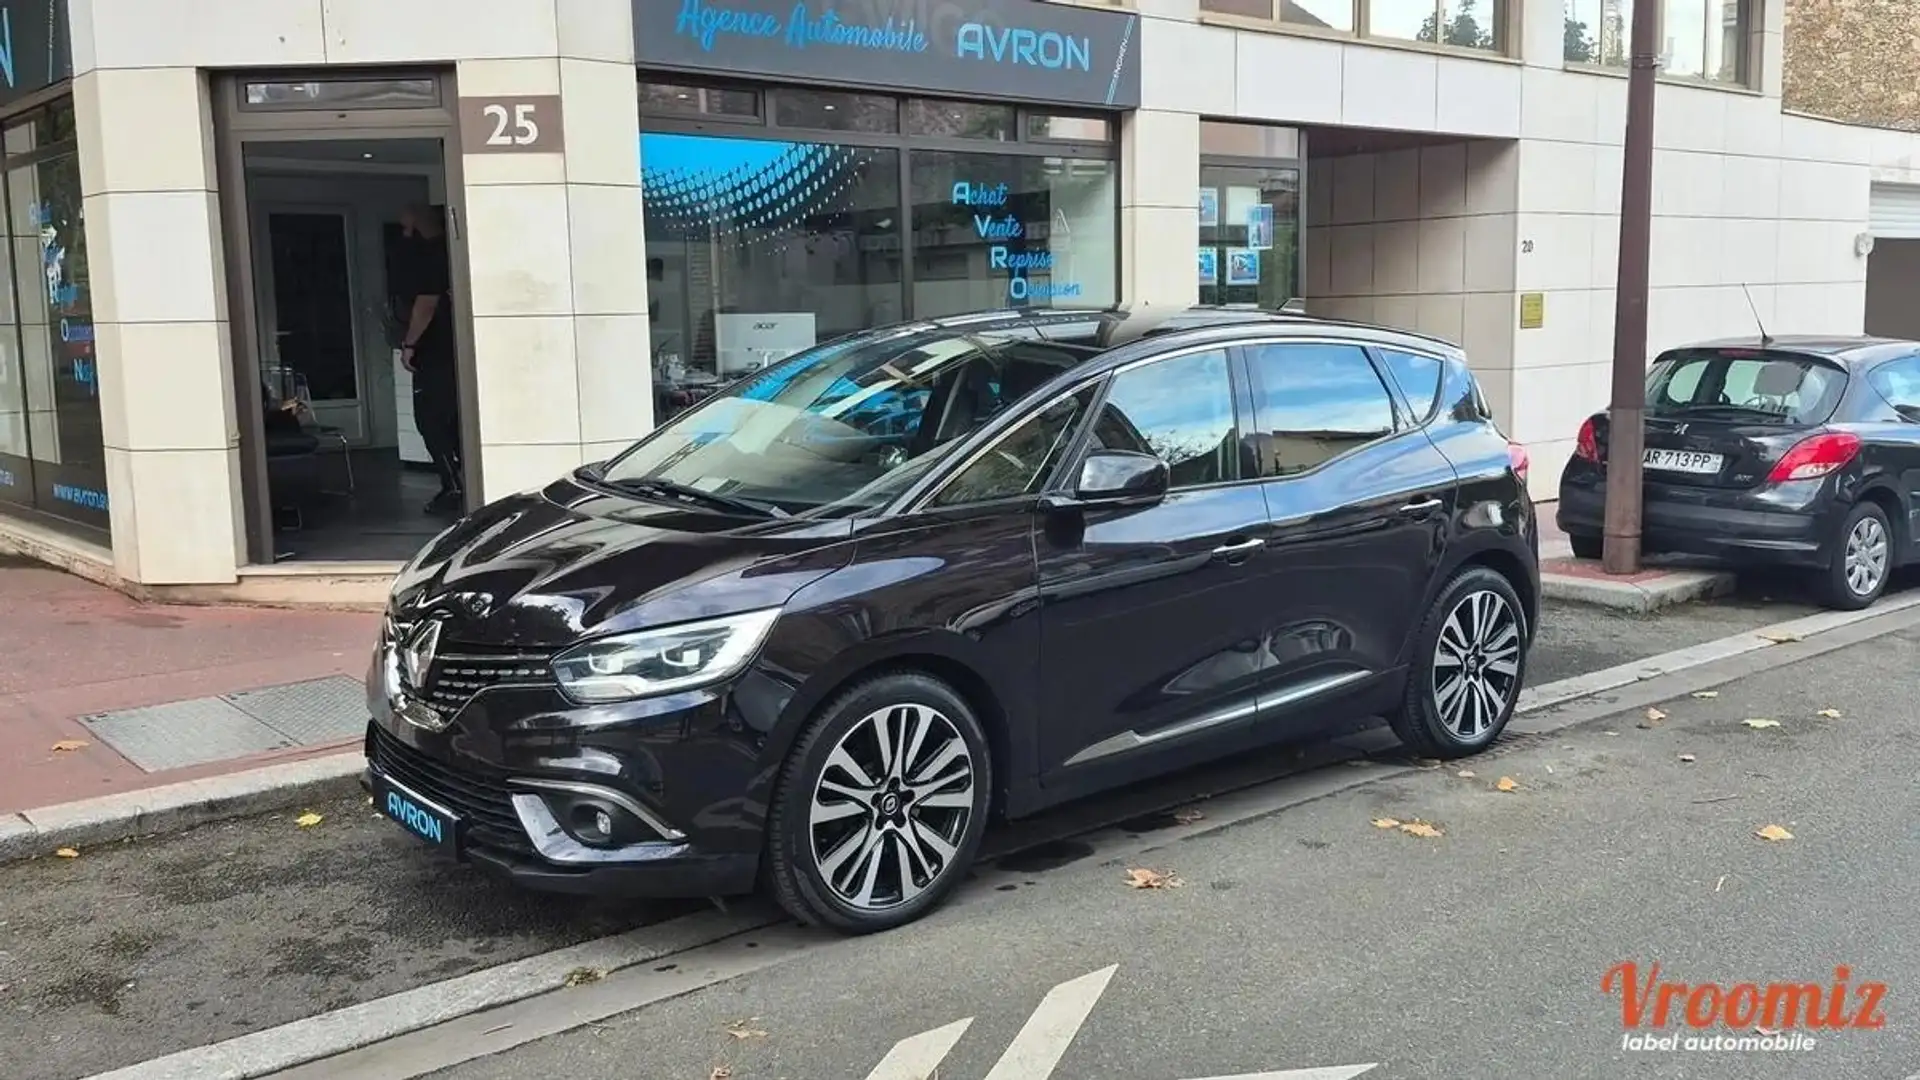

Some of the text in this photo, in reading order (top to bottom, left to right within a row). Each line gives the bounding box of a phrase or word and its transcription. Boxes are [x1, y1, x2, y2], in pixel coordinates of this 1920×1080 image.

[676, 0, 781, 52] Agence
[786, 3, 928, 53] Automobile
[957, 23, 1090, 72] AVRON
[483, 104, 539, 145] 25
[952, 181, 1008, 206] Achat
[974, 213, 1023, 237] Vente
[990, 246, 1057, 277] Reprise
[753, 321, 779, 331] acer
[388, 791, 442, 844] AVRON
